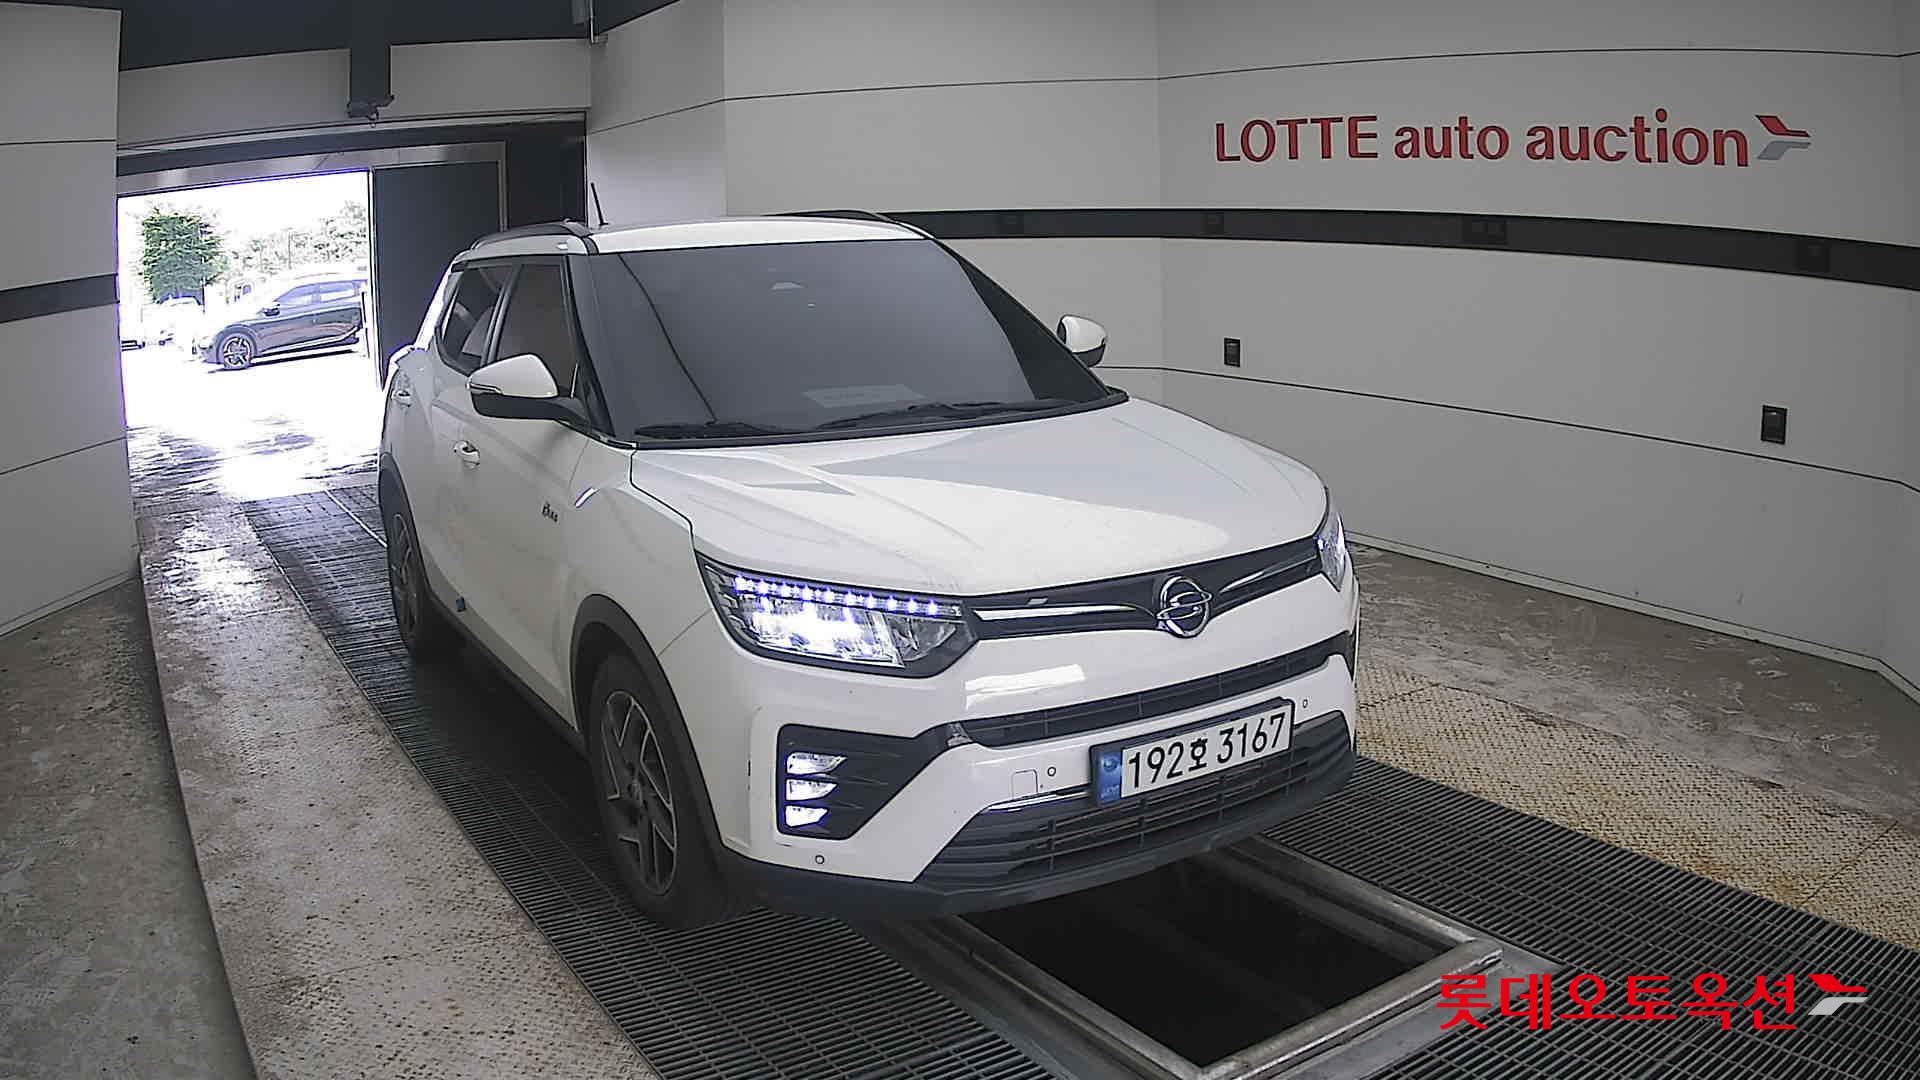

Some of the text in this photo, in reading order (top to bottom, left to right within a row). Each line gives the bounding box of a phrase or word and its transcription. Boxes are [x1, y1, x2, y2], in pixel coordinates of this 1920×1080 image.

[1214, 108, 1749, 167] LOTTE auto auction
[1128, 712, 1286, 788] 192호 3167
